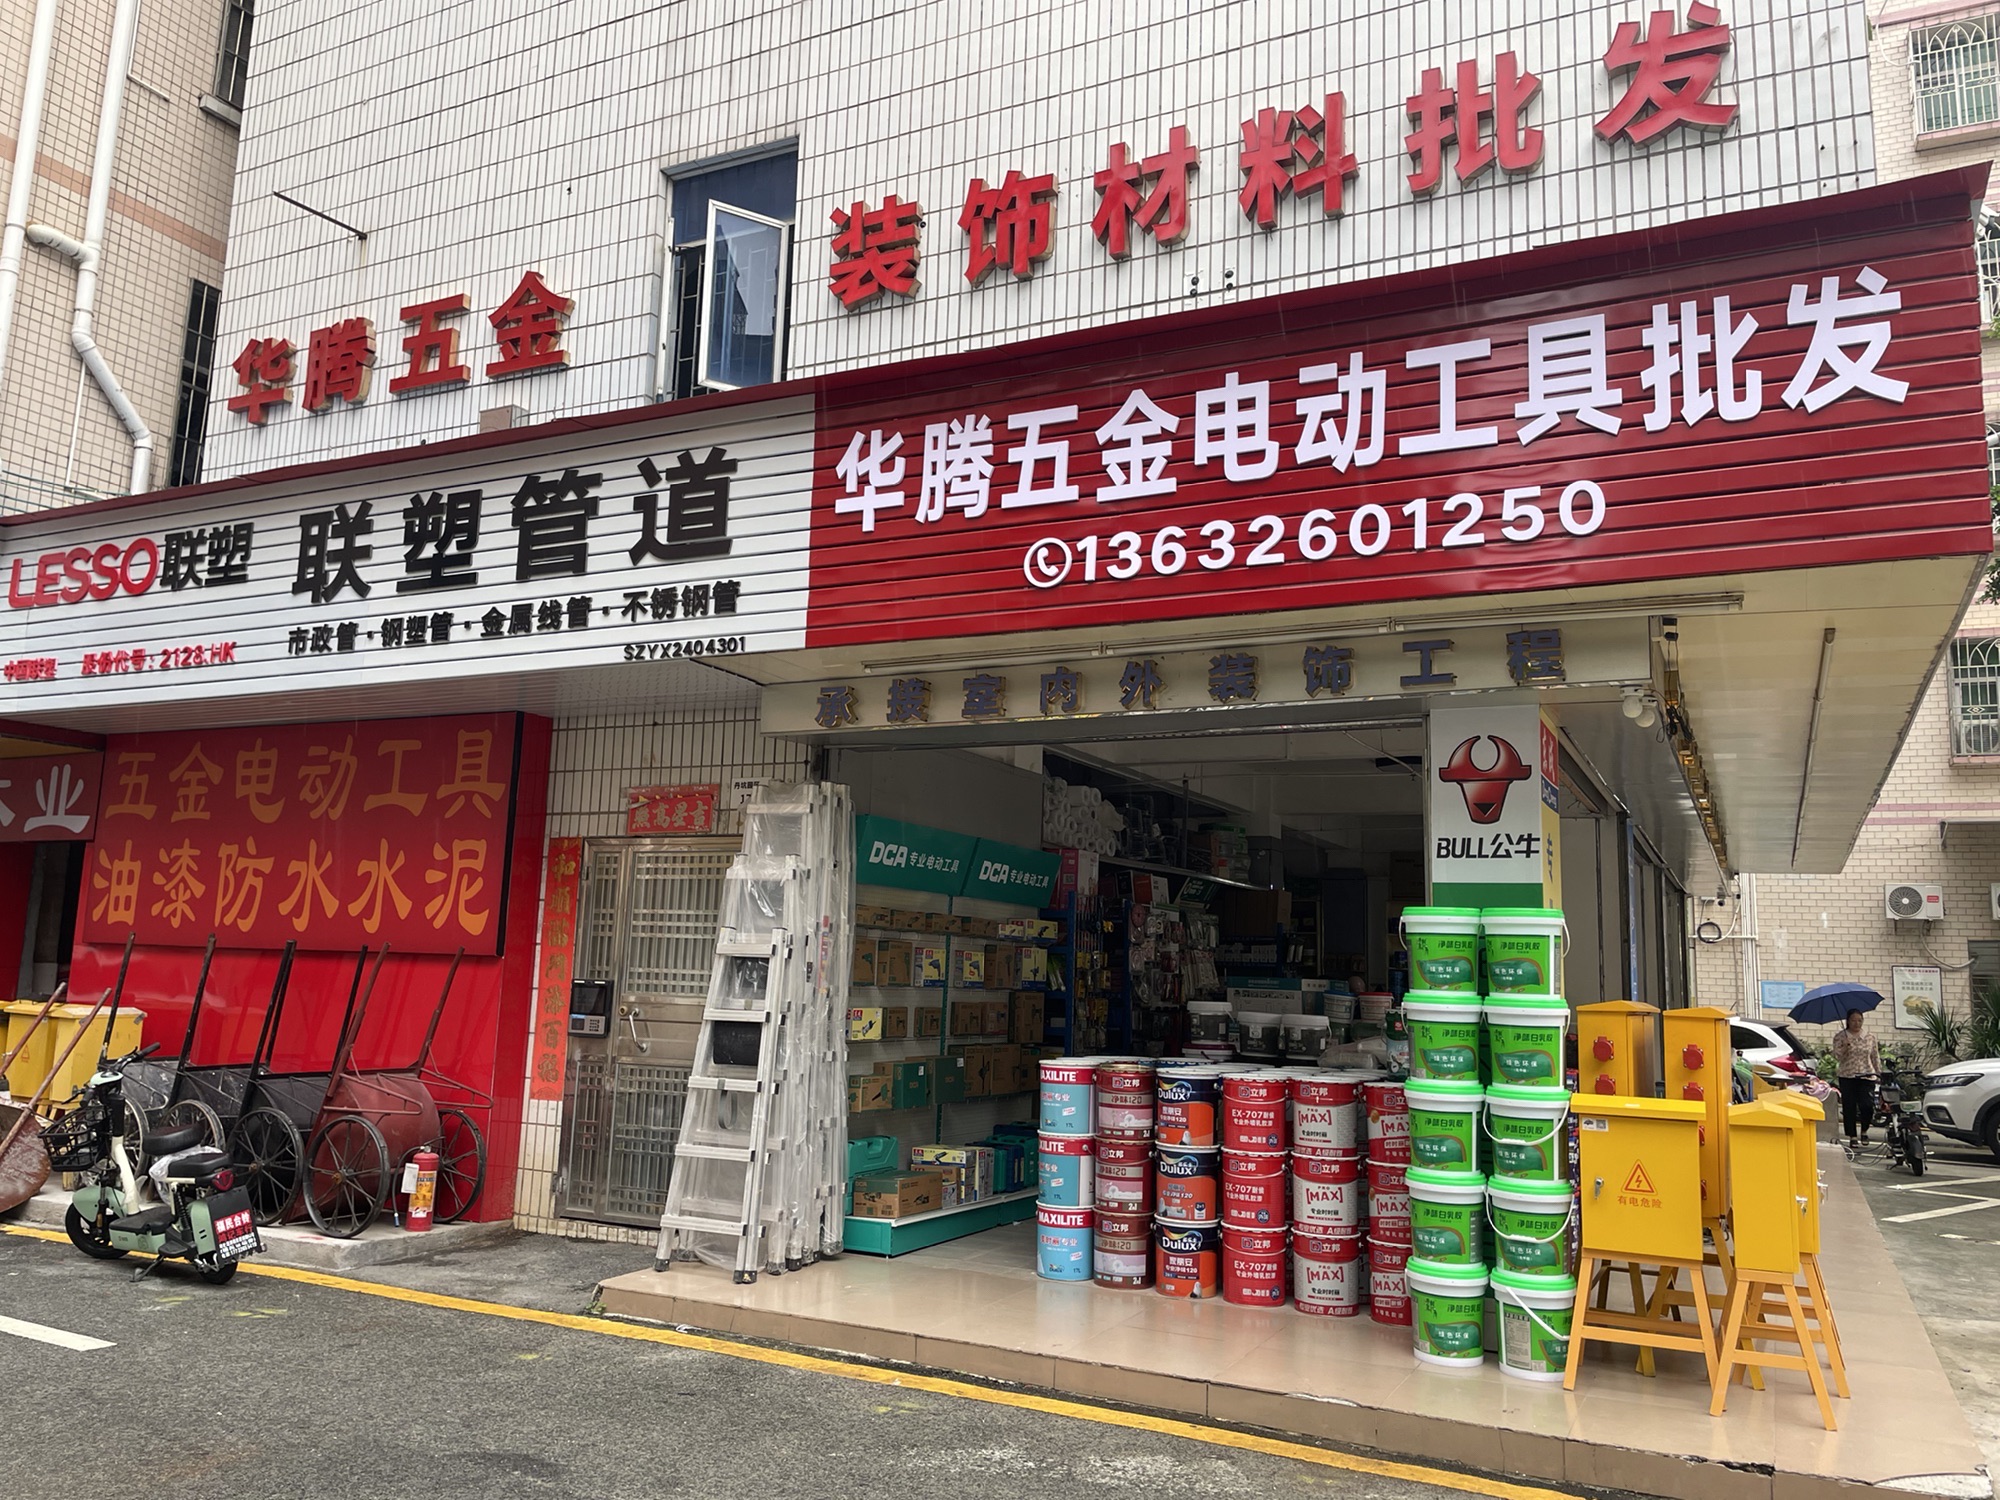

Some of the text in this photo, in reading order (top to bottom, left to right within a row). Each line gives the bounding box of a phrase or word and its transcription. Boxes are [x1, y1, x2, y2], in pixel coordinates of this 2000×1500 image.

[228, 2, 1740, 426] 华腾五金 装饰材料批发
[833, 266, 1911, 533] 华腾五金电动工具批发
[292, 446, 738, 603] 联塑管道
[1075, 478, 1607, 582] 13632601250
[160, 522, 254, 591] 联塑
[8, 537, 160, 608] LESSO
[623, 636, 746, 661] SZYX2404301
[4, 656, 58, 682] 中国联塑
[816, 628, 1567, 727] 承接室内外装饰工程
[105, 728, 506, 824] 五金电动工具
[869, 841, 960, 874] DCA 专业电动工具
[978, 860, 1049, 889] DCA 专业电动工具
[92, 836, 490, 935] 油漆防水水泥
[1433, 1055, 1464, 1063] 绿色环保
[1506, 1059, 1538, 1067] 绿色环保
[1041, 1070, 1076, 1082] AXILITE
[1124, 1079, 1140, 1087] 立邦
[1158, 1088, 1186, 1100] Dulux
[1250, 1089, 1267, 1097] 立邦
[1310, 1087, 1328, 1096] 立邦
[1108, 1149, 1124, 1158] 立邦
[1418, 1143, 1447, 1152] 绿色环保
[1498, 1150, 1526, 1160] 绿色环保
[1160, 1161, 1192, 1175] Dulux
[1239, 1162, 1256, 1171] 立邦
[1322, 1164, 1340, 1173] 立邦
[1618, 1195, 1662, 1208] 有电危险
[1038, 1212, 1083, 1225] MAXILITE
[1113, 1223, 1129, 1232] 立邦
[1162, 1236, 1197, 1250] Dulux
[1253, 1240, 1271, 1249] 立邦
[1418, 1235, 1446, 1244] 绿色环保
[1322, 1243, 1340, 1252] 立邦
[1510, 1246, 1541, 1255] 绿色环保
[1384, 1254, 1401, 1264] 立邦
[1438, 1331, 1470, 1339] 绿色环保
